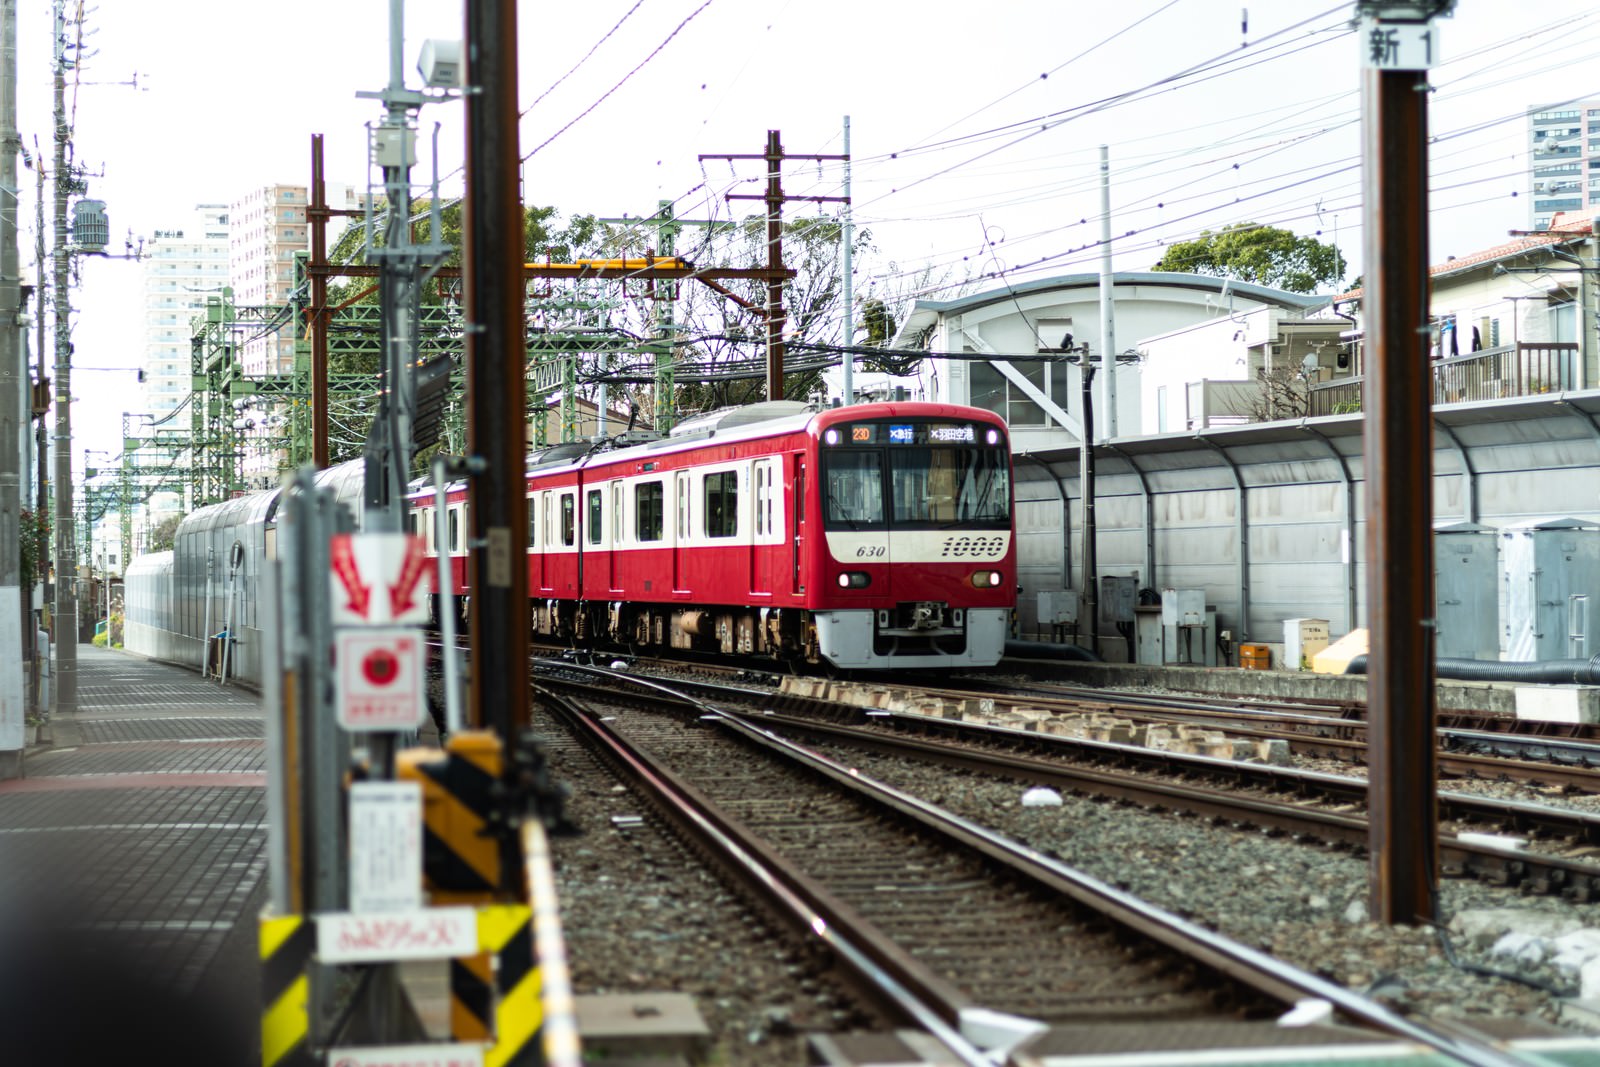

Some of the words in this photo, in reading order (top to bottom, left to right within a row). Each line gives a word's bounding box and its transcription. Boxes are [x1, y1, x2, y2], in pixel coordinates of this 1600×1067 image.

[1369, 27, 1400, 66] 新
[1419, 30, 1432, 64] 1
[939, 427, 974, 441] 羽田空港
[856, 545, 886, 558] 630
[942, 537, 1003, 557] 1000
[981, 699, 994, 713] 20
